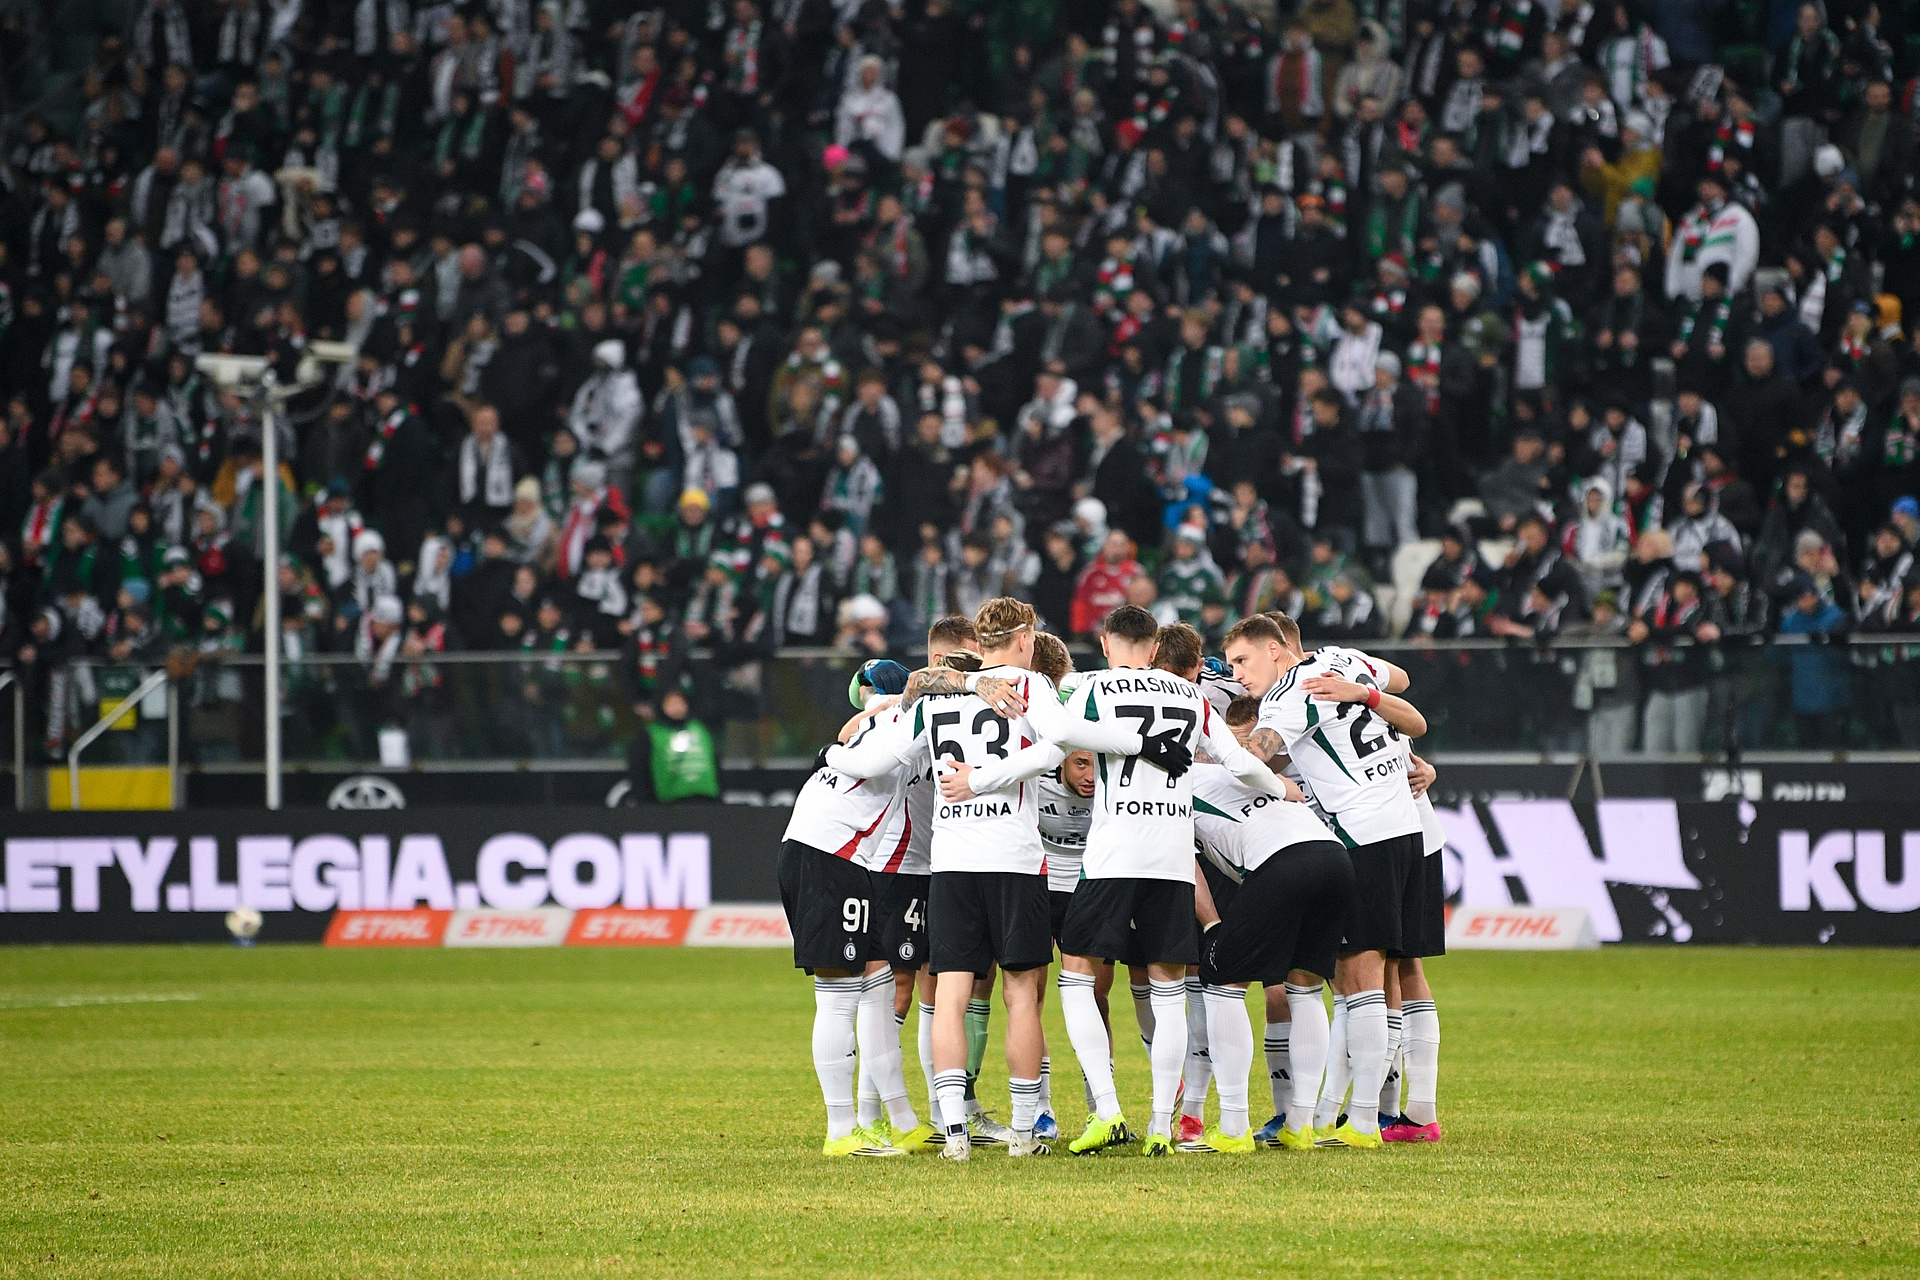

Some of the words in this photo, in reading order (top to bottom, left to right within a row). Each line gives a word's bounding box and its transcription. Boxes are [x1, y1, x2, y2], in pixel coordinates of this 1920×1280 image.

[1101, 677, 1199, 700] KRASNIQI
[931, 708, 1010, 778] 53
[1114, 705, 1197, 788] 77
[940, 802, 1012, 819] ORTUNA
[0, 833, 710, 913] ETY.LEGIA.COM
[843, 897, 869, 933] 91
[340, 917, 431, 939] STIHL
[462, 917, 547, 938] STIHL
[580, 916, 673, 939] STIHL
[704, 917, 788, 937] STIHL
[1463, 916, 1561, 938] STIHL
